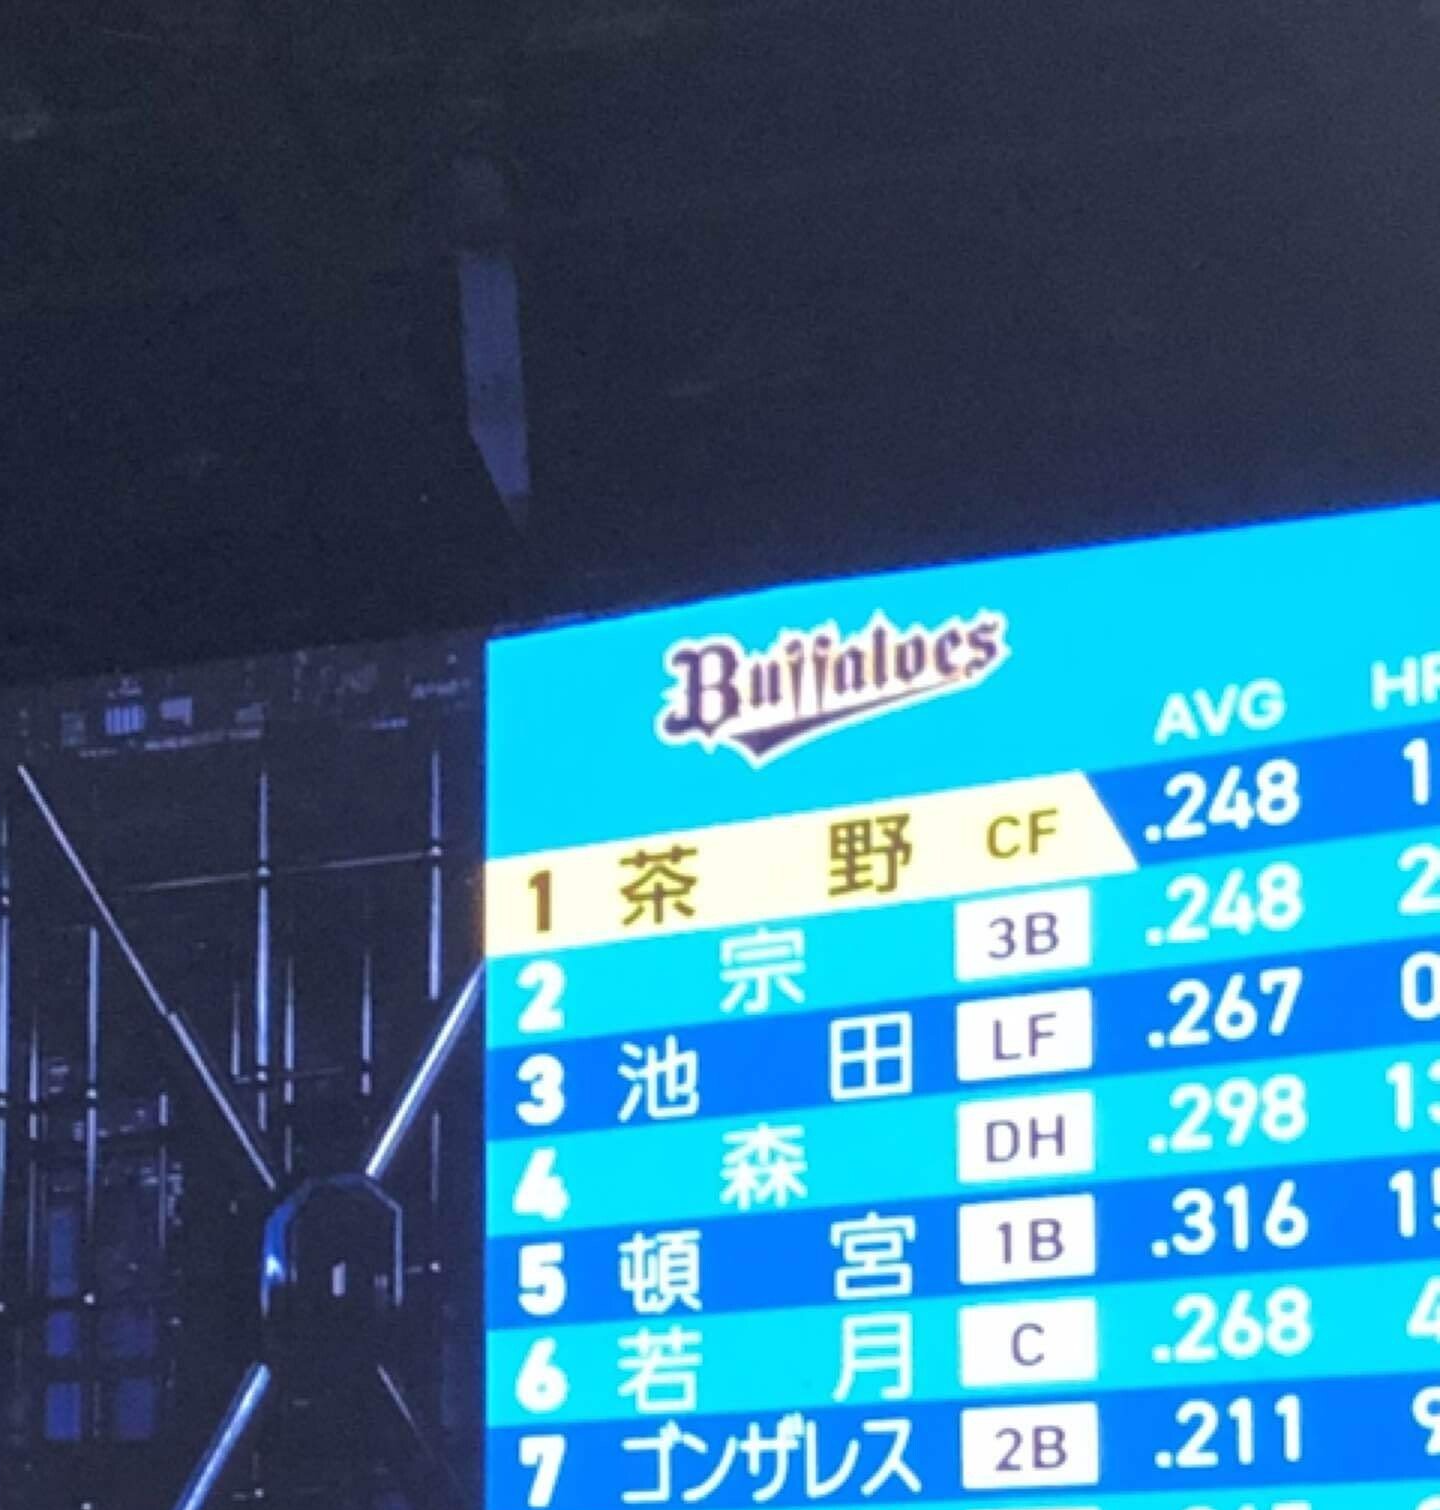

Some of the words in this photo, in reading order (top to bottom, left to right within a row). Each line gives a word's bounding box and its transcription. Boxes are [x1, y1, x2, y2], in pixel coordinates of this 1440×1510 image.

[660, 612, 1008, 765] Buffaloes
[1156, 680, 1284, 742] AVG
[529, 870, 550, 932] 1
[987, 809, 1056, 858] CF
[1146, 760, 1299, 841] .248
[1404, 739, 1428, 804] 1
[519, 961, 564, 1032] 2
[718, 929, 806, 1013] 宗
[988, 911, 1060, 960] 3B
[1147, 864, 1302, 944] .248
[1400, 844, 1440, 913] 2
[518, 1055, 564, 1124] 3
[994, 1014, 1058, 1062] LF
[1149, 967, 1302, 1047] .267
[514, 1149, 568, 1218] 4
[723, 1125, 805, 1209] 森
[986, 1116, 1068, 1166] DH
[1150, 1075, 1306, 1152] .298
[520, 1243, 565, 1314] 5
[999, 1219, 1063, 1263] 1B
[1152, 1181, 1307, 1256] .316
[1390, 1168, 1440, 1236] 1
[517, 1339, 567, 1411] 6
[1012, 1323, 1044, 1366] C
[1154, 1287, 1312, 1361] .268
[520, 1435, 565, 1507] 7
[622, 1413, 923, 1503] ゴンザレス
[996, 1426, 1066, 1471] 2B
[1156, 1396, 1299, 1467] .211
